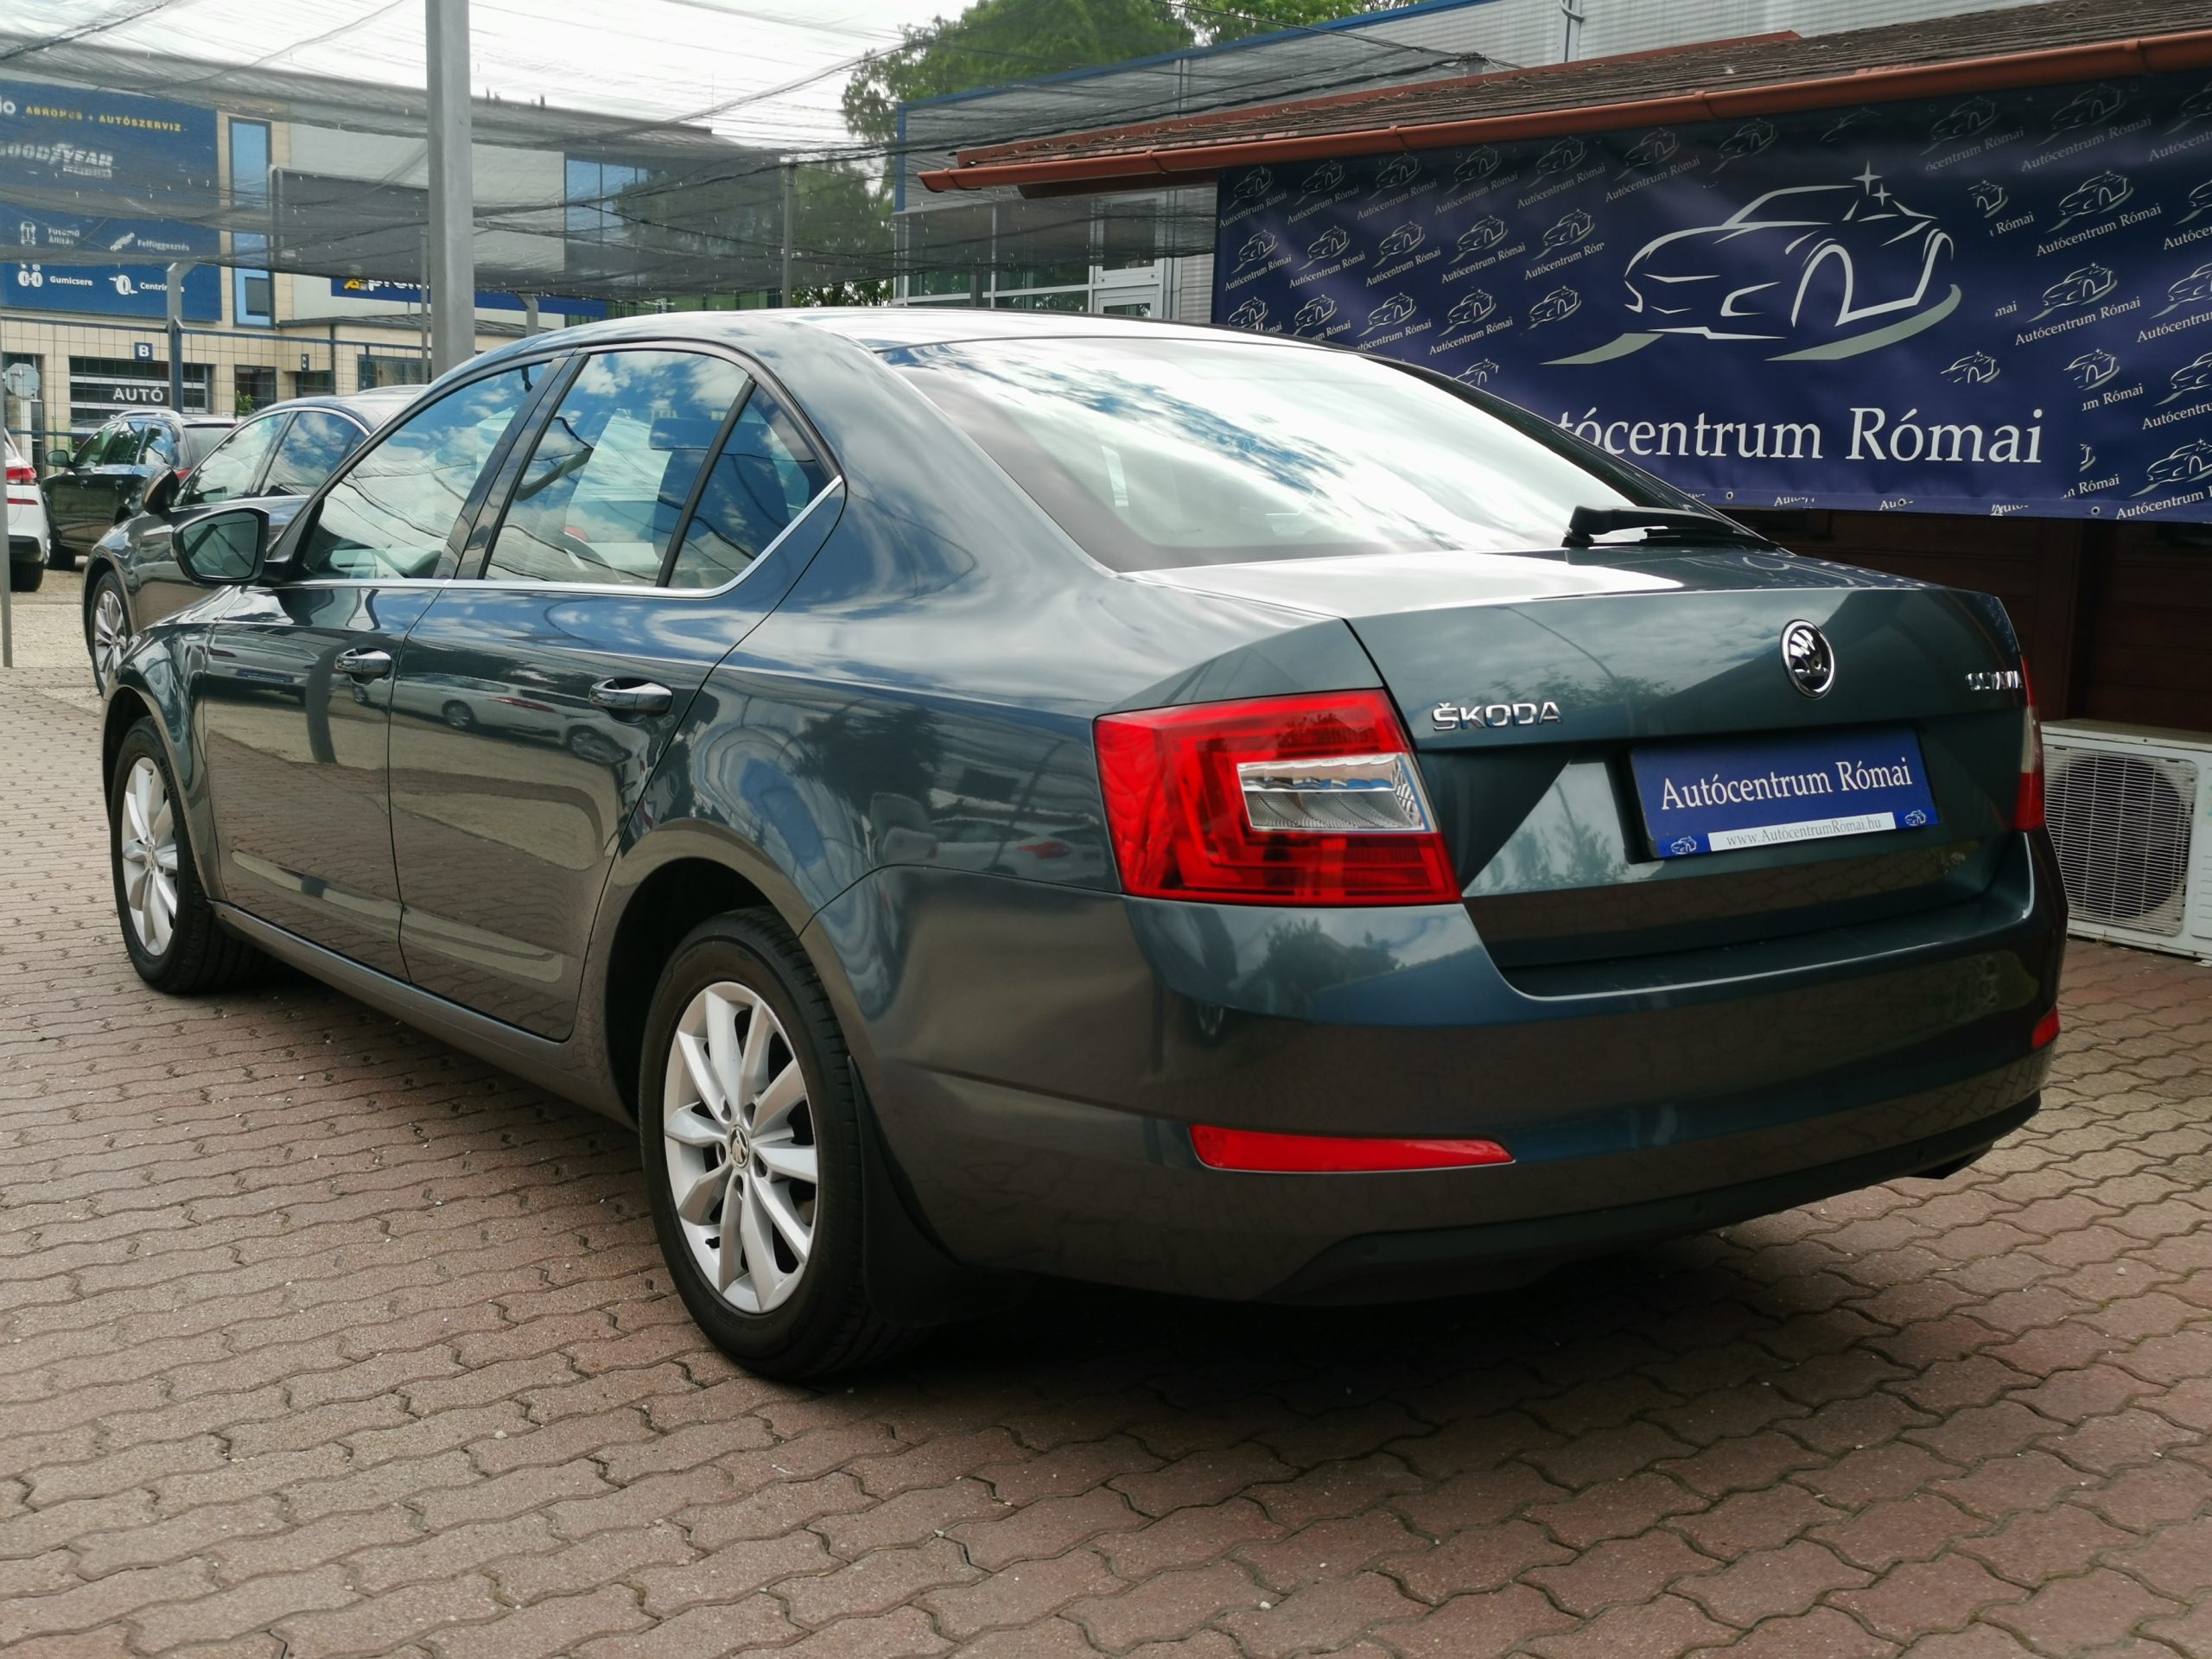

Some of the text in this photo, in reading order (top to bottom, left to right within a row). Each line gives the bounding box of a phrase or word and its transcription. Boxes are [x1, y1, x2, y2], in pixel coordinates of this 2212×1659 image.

[99, 114, 181, 132] AUTÓSZERVIZ
[1435, 170, 1518, 215] Autócentrum Római
[1517, 162, 1606, 209] Autócentrum Római
[1605, 154, 1700, 203] Autócentrum Római
[1219, 189, 1287, 228] Autócentrum Római
[1287, 184, 1360, 225] Autócentrum Római
[1357, 178, 1438, 220] Autócentrum Római
[1996, 211, 2035, 235] Római
[2037, 202, 2162, 257] Autócentrum Római
[50, 276, 93, 287] Gumicsere
[1224, 254, 1292, 292] Autócentrum Római
[1289, 251, 1366, 289] Autócentrum Római
[1366, 246, 1441, 288] Autócentrum Római
[1442, 241, 1526, 284] Autócentrum Római
[1525, 251, 1582, 281] Autócentrum
[140, 281, 185, 293] Centrírs
[1406, 319, 1432, 336] Római
[1429, 316, 1513, 355] Autócentrum Római
[2015, 296, 2141, 346] Autócentrum Római
[138, 345, 149, 358] B
[113, 387, 164, 403] AUTÓ
[2103, 383, 2144, 405] Római
[1846, 406, 2044, 463] Római
[2079, 474, 2120, 495] Római
[2116, 492, 2204, 520] Autócentrum
[1433, 702, 1563, 730] ŠKODA
[1662, 756, 1913, 810] Autócentrum Római
